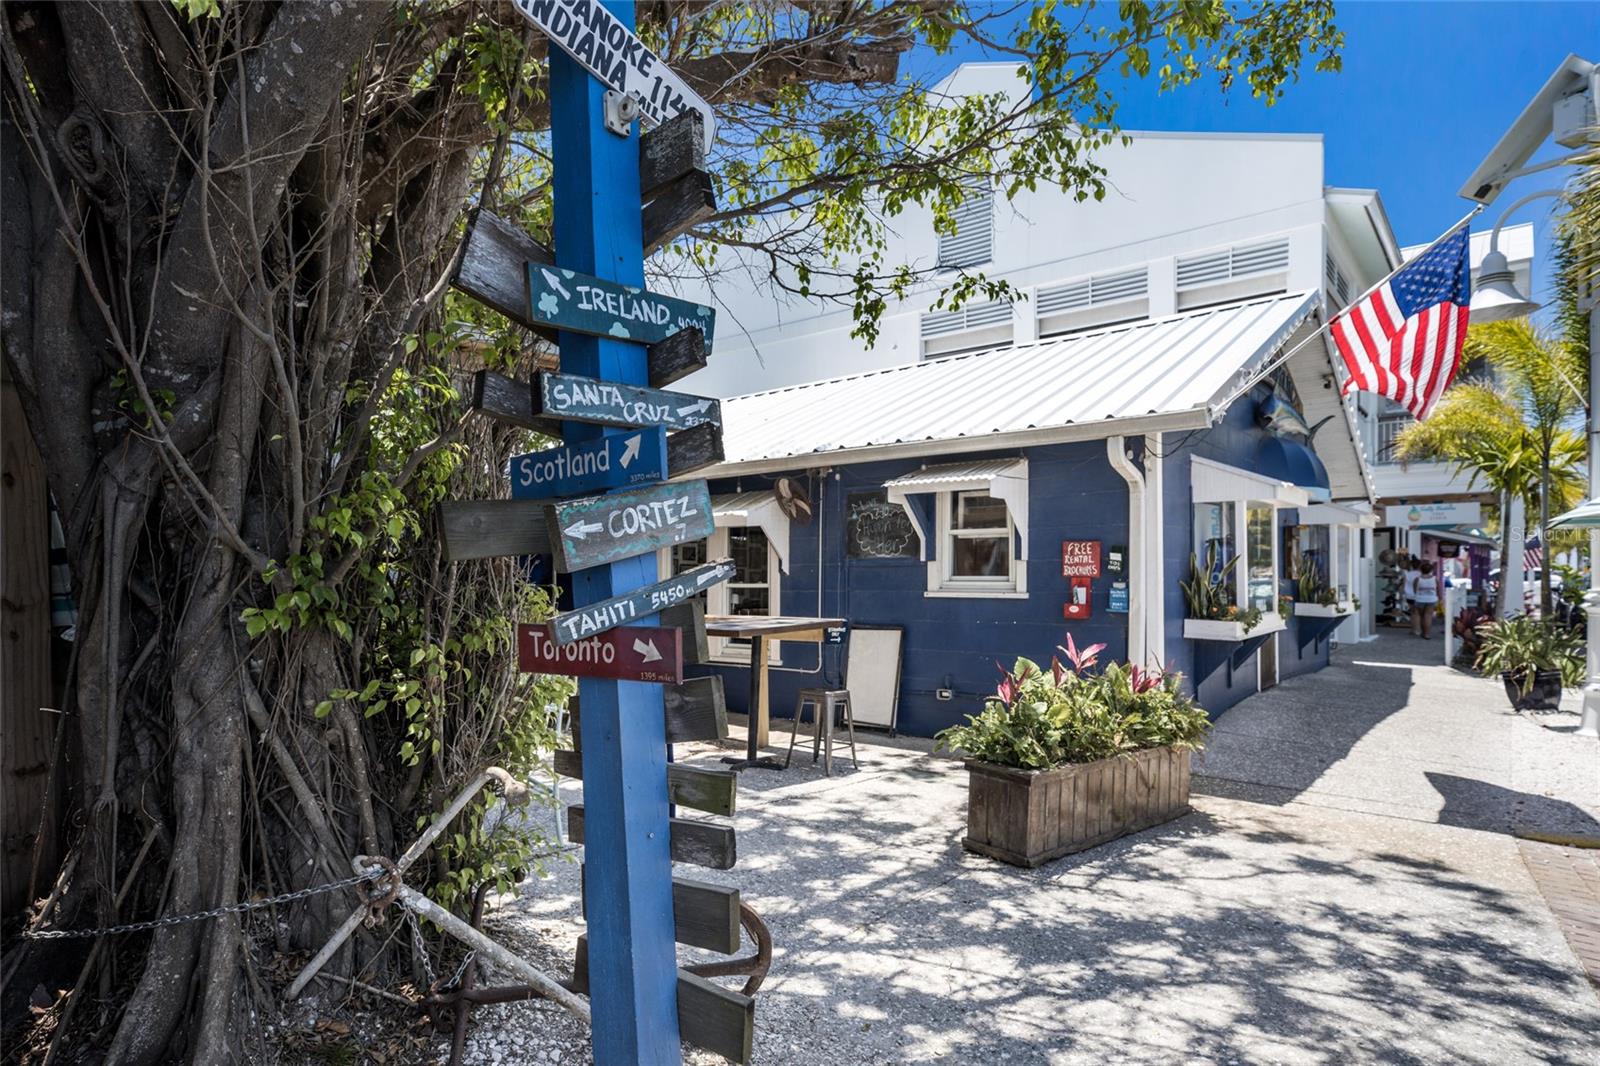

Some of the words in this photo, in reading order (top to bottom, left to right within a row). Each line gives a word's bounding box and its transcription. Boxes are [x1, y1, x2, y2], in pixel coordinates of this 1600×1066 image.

[560, 0, 656, 77] ANOKE
[576, 286, 670, 325] IRELAND
[553, 384, 625, 408] SANTA
[623, 401, 676, 423] CRUZ
[519, 440, 610, 487] Scotland
[608, 495, 698, 538] CORTEZ
[1064, 555, 1095, 564] RENTAL
[1067, 542, 1092, 555] FREE
[562, 600, 636, 640] TAHITI
[651, 584, 685, 610] 5450
[528, 631, 615, 664] Toronto
[640, 671, 656, 681] 1395
